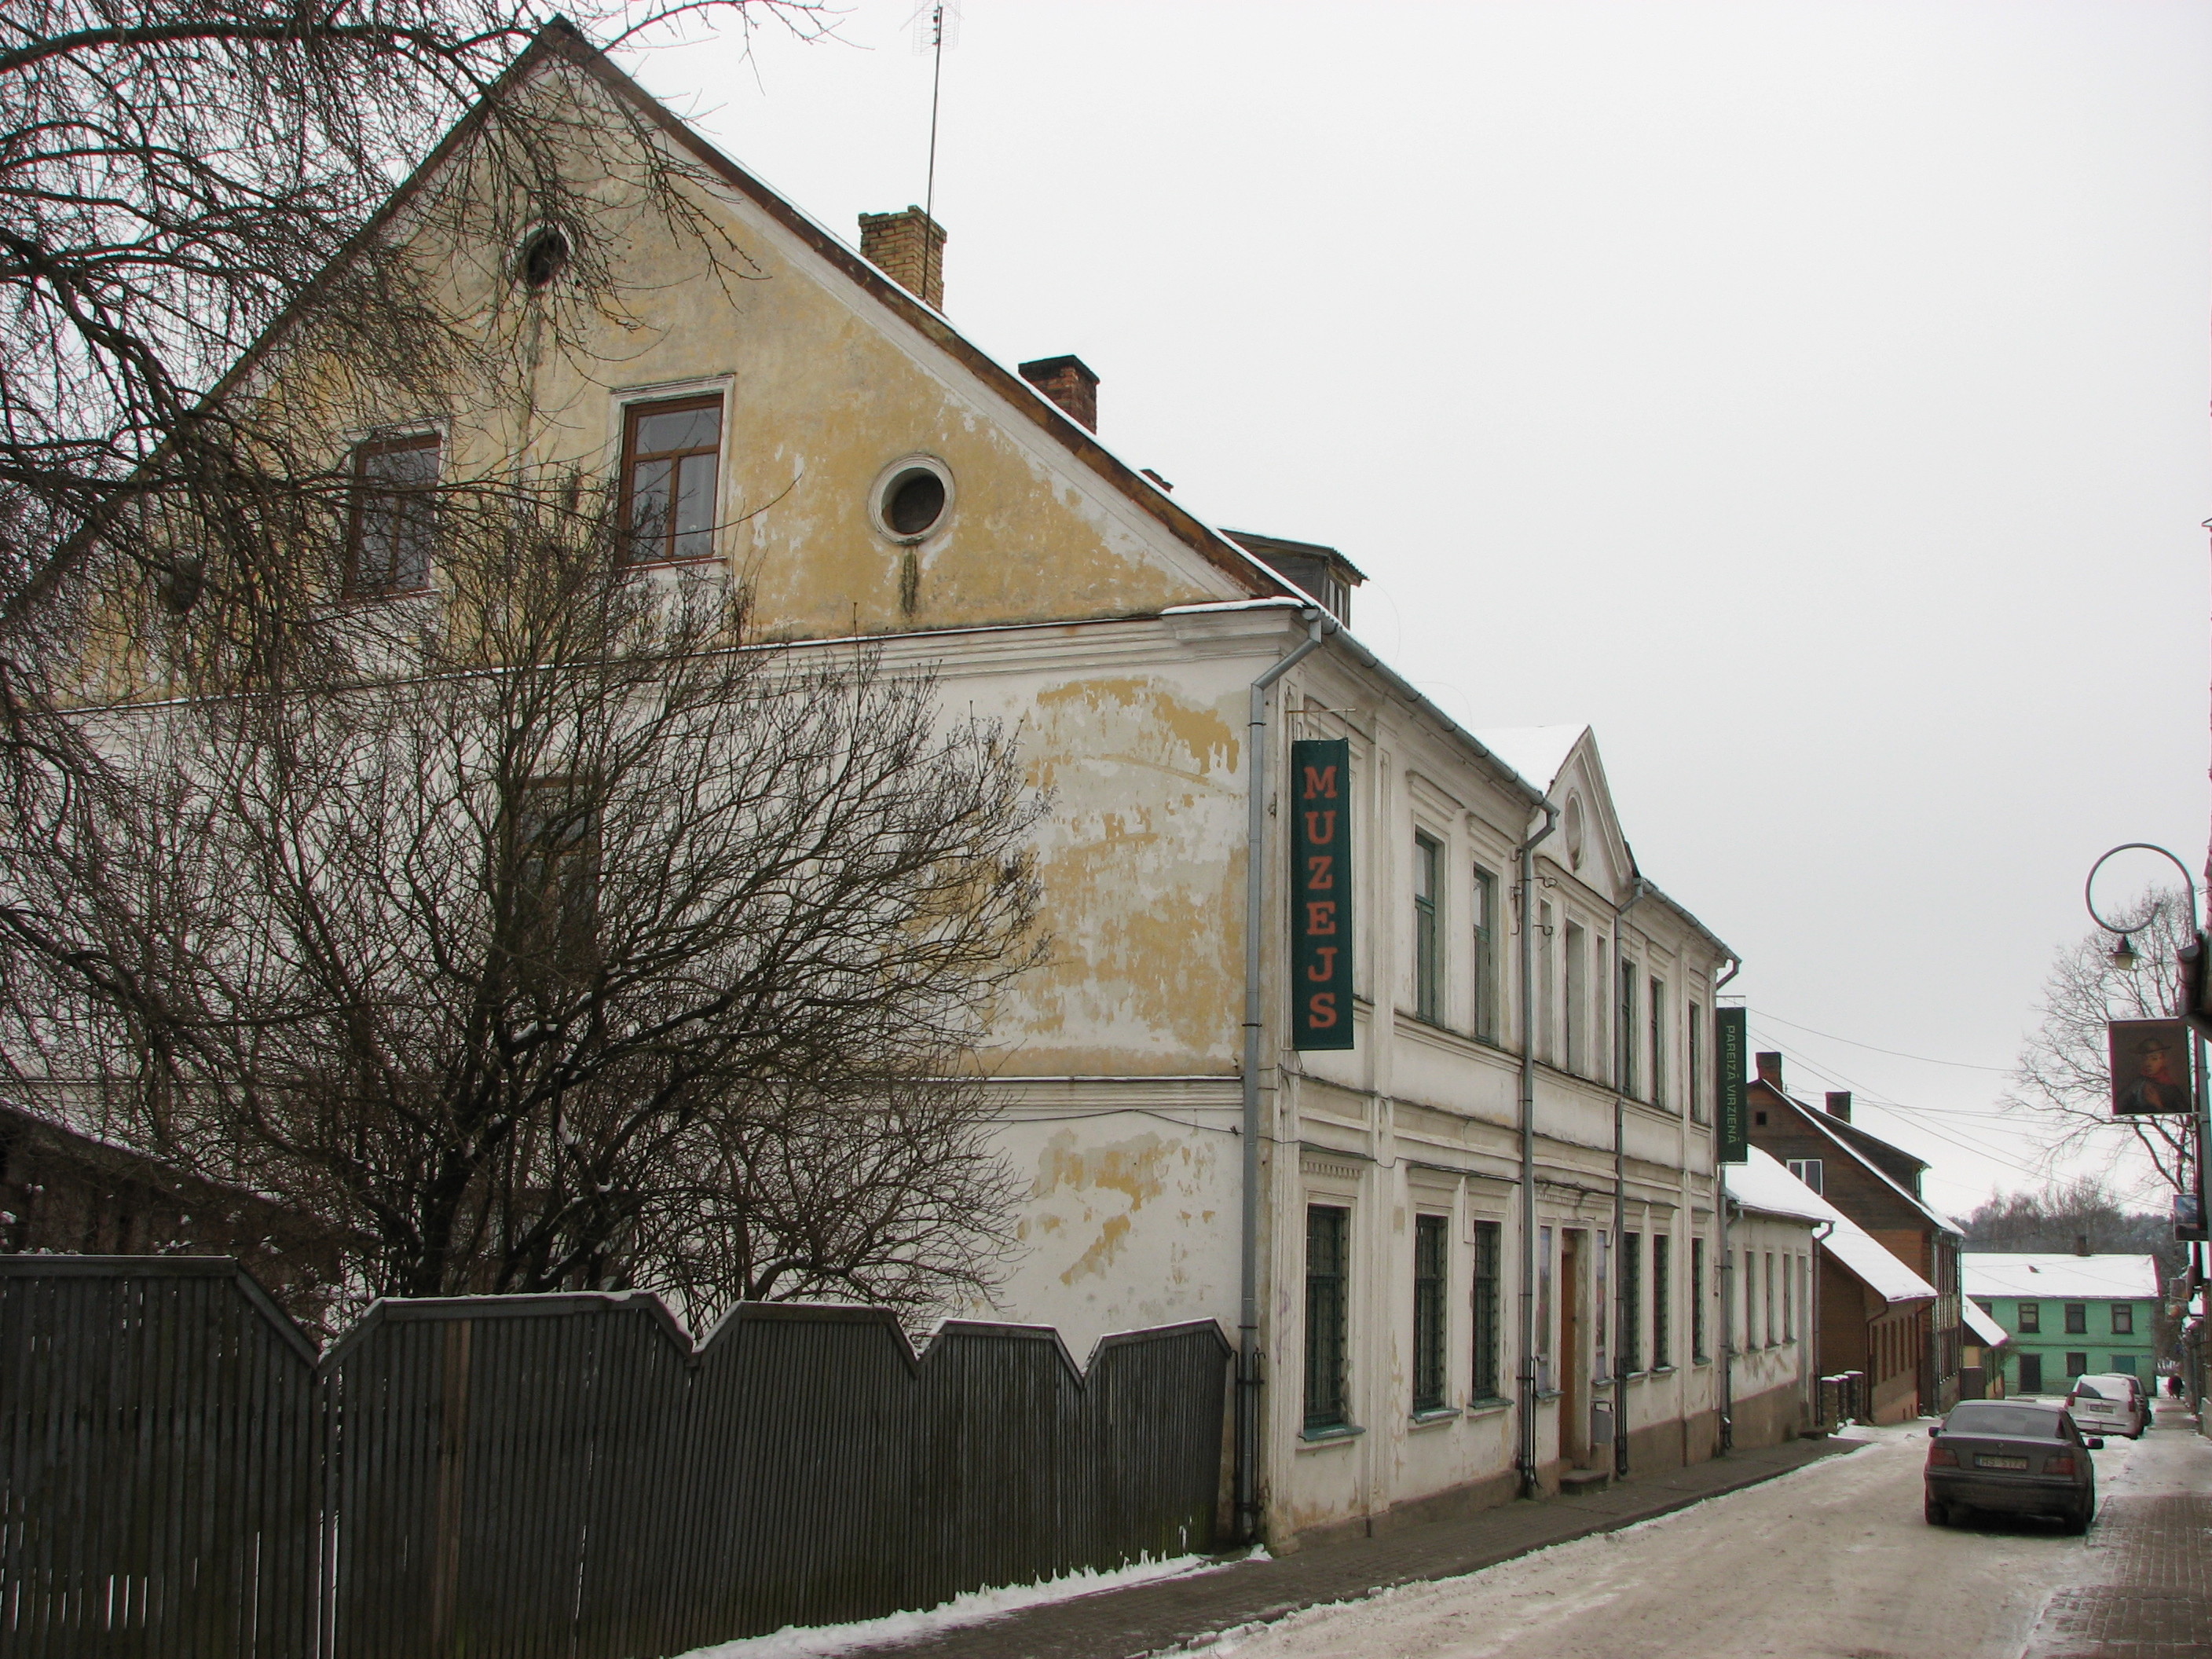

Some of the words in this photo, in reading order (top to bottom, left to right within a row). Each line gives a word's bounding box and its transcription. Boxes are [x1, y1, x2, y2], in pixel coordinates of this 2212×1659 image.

[1303, 765, 1339, 1029] MUZEJS
[1726, 1024, 1740, 1081] PAREIZĀ
[1727, 1084, 1741, 1144] VIRZIENĀ
